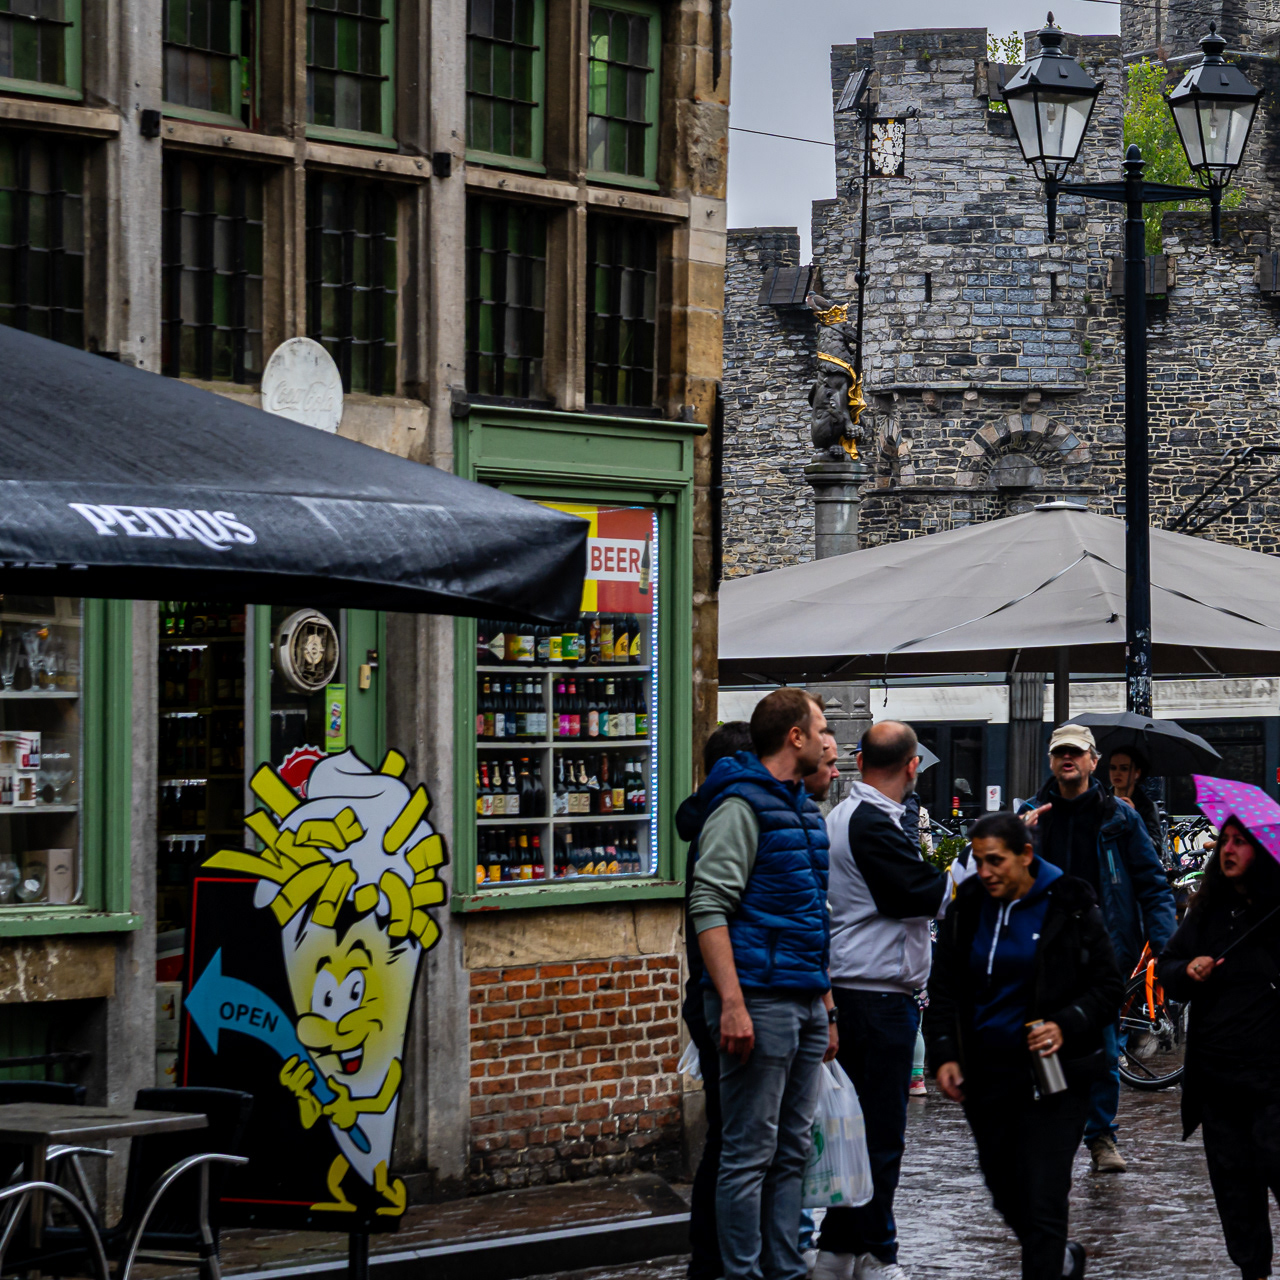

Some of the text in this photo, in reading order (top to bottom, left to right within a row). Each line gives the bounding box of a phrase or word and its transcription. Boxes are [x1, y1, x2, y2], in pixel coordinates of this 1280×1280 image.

[68, 503, 257, 551] PETRUS
[591, 545, 642, 574] BEER
[219, 1001, 279, 1033] OPEN
